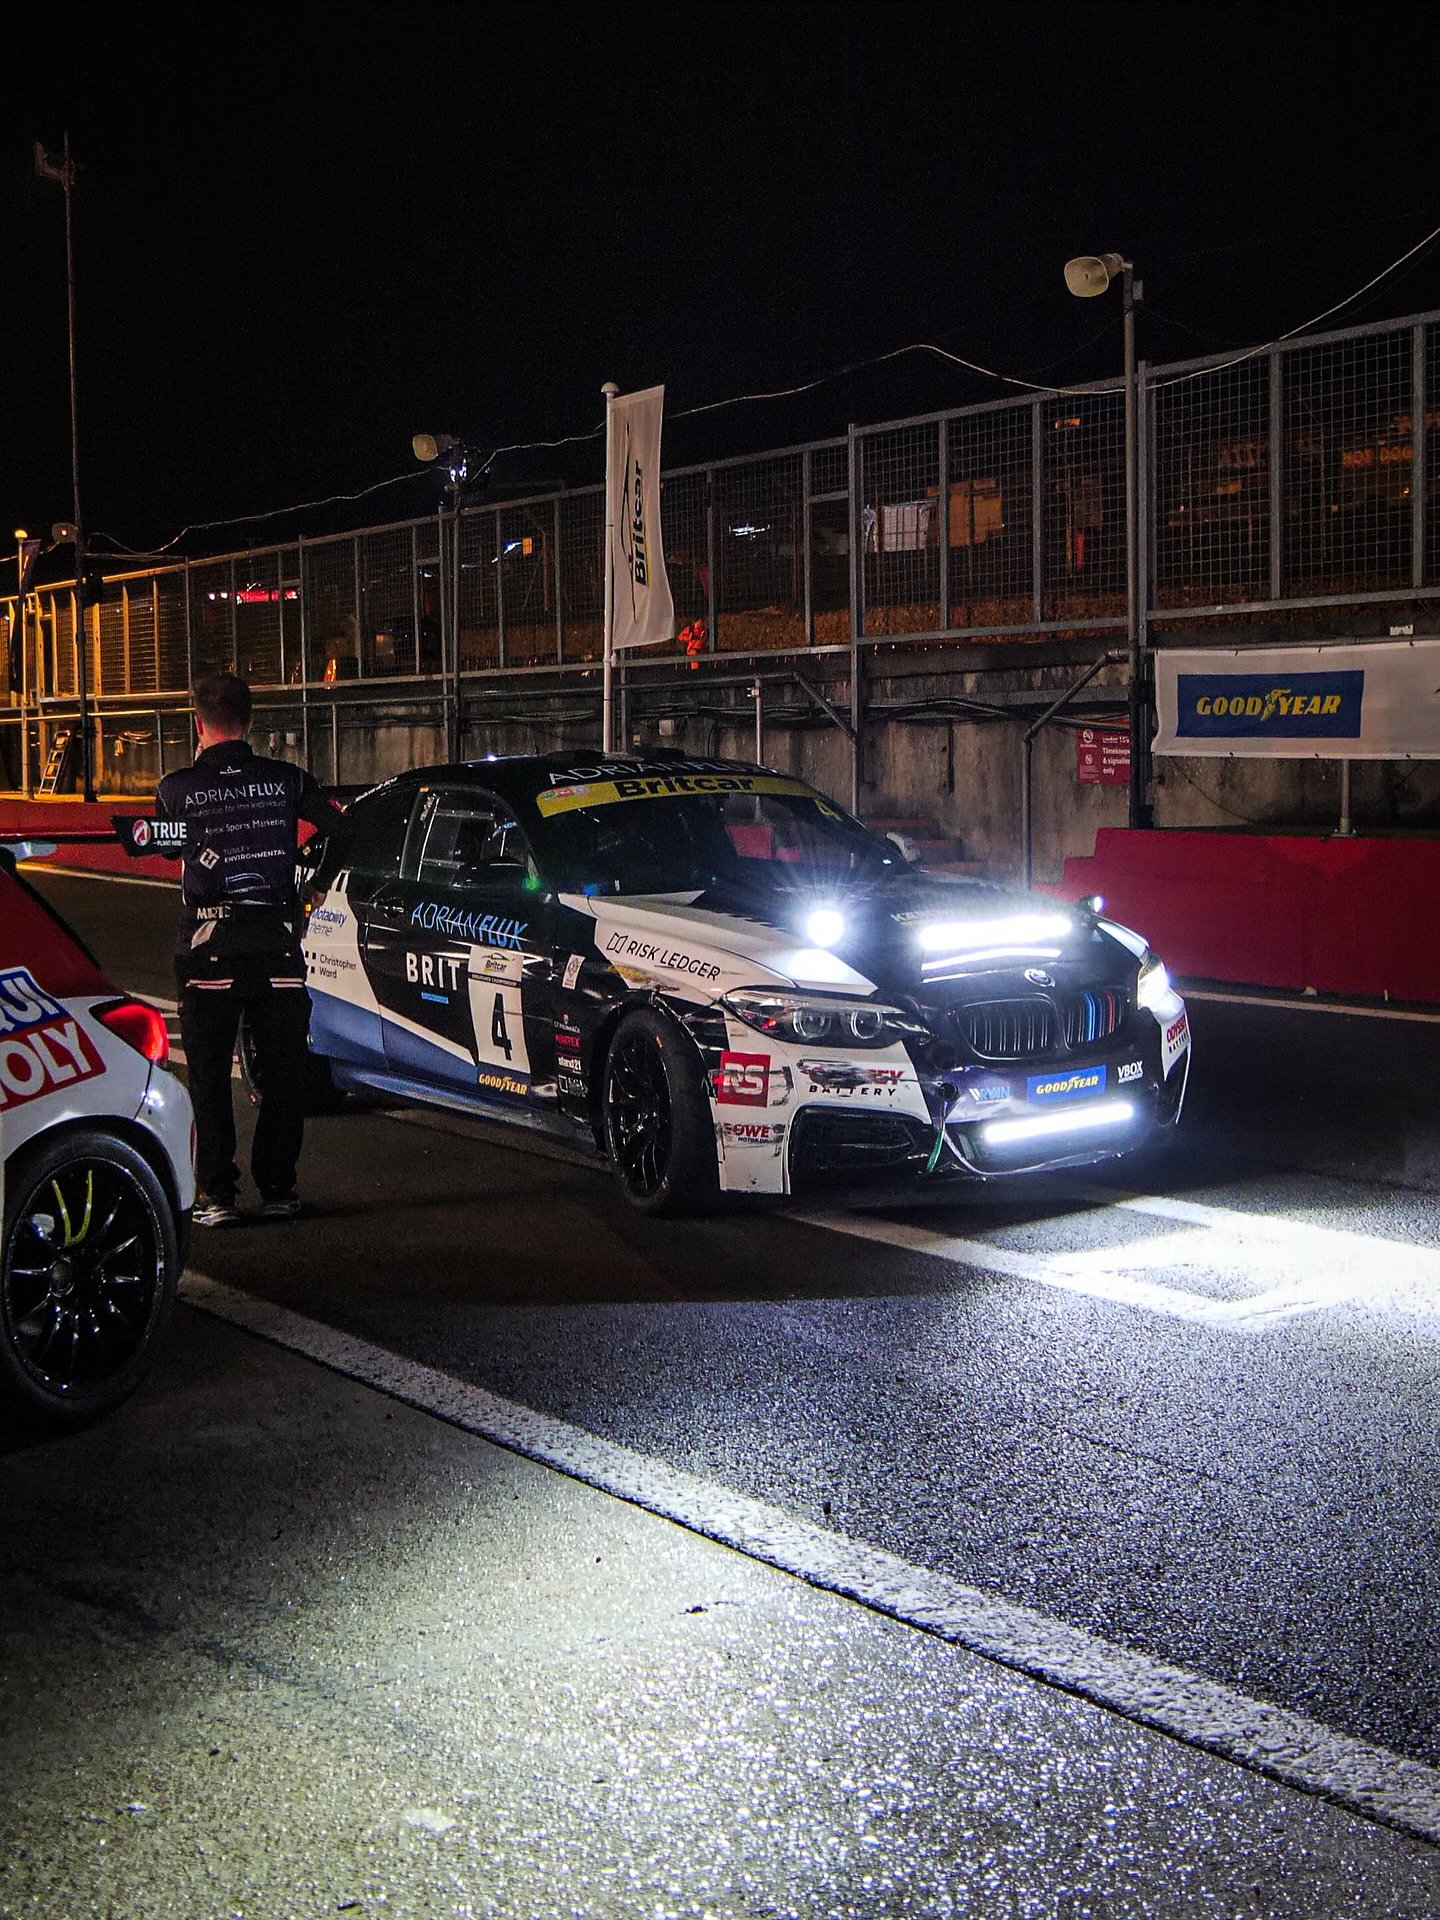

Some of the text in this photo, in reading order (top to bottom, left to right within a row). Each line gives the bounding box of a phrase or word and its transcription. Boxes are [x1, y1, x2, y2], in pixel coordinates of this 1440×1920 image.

[632, 459, 650, 587] Britcar
[1196, 692, 1342, 719] GOODYEAR
[614, 776, 753, 799] Britcar
[150, 822, 187, 839] TRUE
[411, 901, 529, 952] ADRIANFLUX
[319, 953, 357, 970] Christopher
[406, 951, 460, 991] BRIT
[626, 940, 721, 981] RISK LEDGER
[319, 967, 337, 979] Ward
[491, 992, 513, 1061] 4
[0, 1021, 92, 1104] OLY
[1117, 1060, 1143, 1079] VBOX
[478, 1073, 529, 1096] GOODYEAR
[809, 1083, 897, 1097] BATTERY
[1035, 1076, 1099, 1095] GOODYEAR
